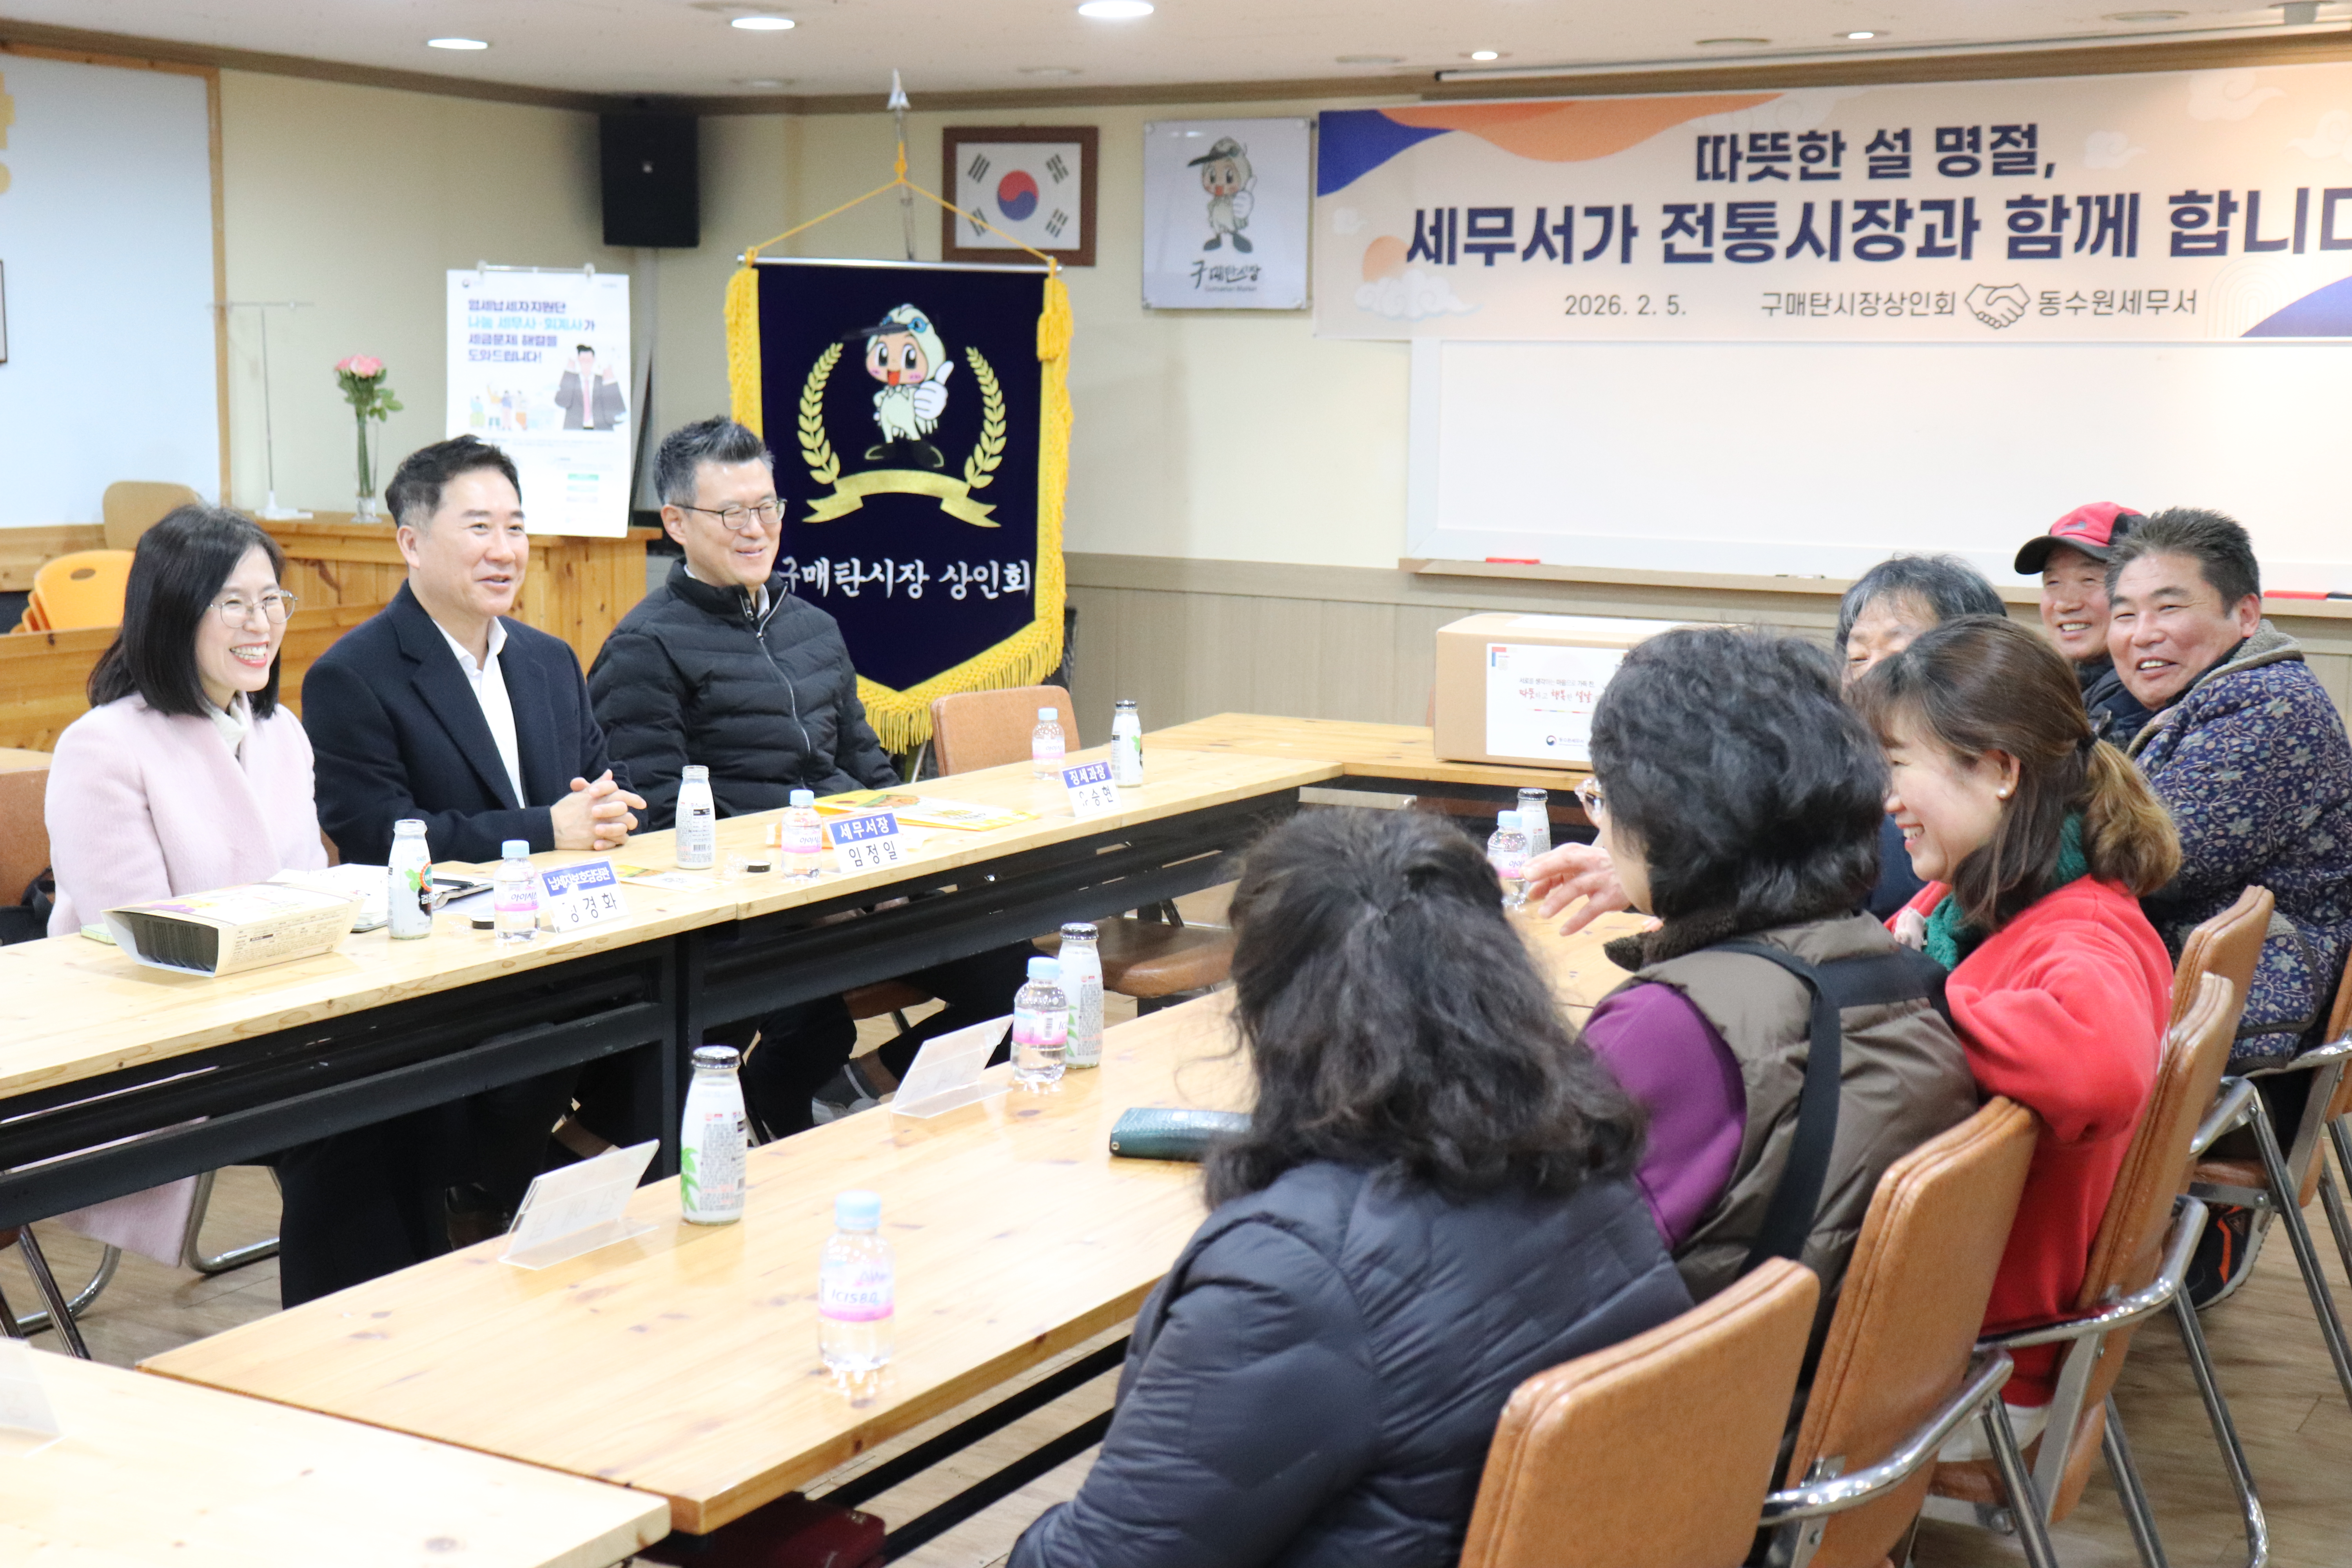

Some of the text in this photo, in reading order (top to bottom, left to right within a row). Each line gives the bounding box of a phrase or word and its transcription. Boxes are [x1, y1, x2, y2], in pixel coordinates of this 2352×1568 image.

[1696, 123, 2056, 183] 따뜻한 설 명절,
[1406, 203, 1638, 266] 세무서가
[1661, 197, 1980, 264] 전통시장과
[2005, 192, 2141, 260] 함께
[1564, 294, 1686, 316] 2026. 2. 5.
[1761, 289, 2197, 317] 구매탄시장상인회 동수원세무서
[780, 556, 1031, 600] 구매탄시장 상인회
[1576, 690, 1593, 703] 설날
[1069, 764, 1106, 785] 징세과장
[840, 817, 889, 840] 세무서장
[548, 866, 610, 890] 납세자보호담당관
[511, 891, 537, 901] 아이시스
